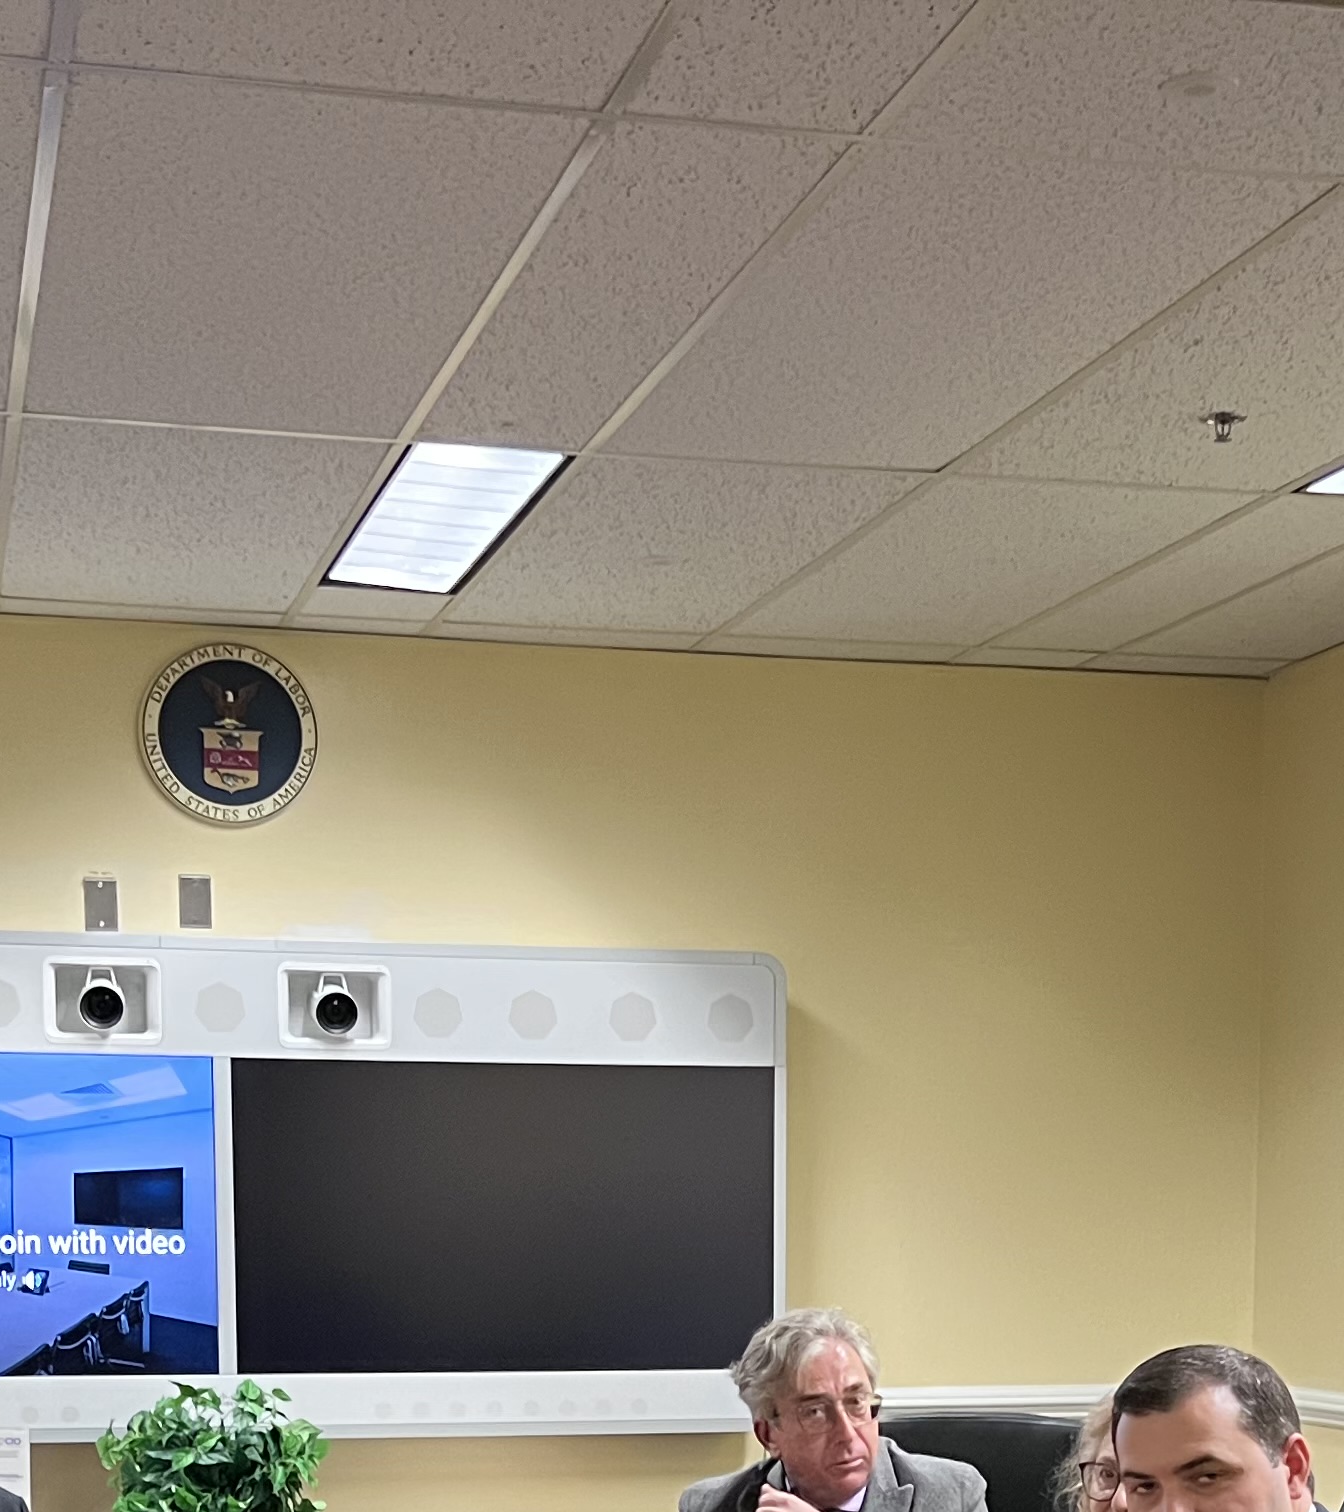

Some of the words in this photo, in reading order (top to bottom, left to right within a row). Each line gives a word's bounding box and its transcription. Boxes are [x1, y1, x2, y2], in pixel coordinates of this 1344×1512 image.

[151, 646, 245, 705] DEPARTMENT
[252, 652, 272, 669] OF
[275, 666, 311, 719] LABOR
[145, 732, 181, 795] UNITED
[185, 795, 240, 821] STATES
[248, 804, 266, 819] OF
[272, 747, 315, 810] AMERICA
[48, 1229, 106, 1255] with
[113, 1228, 186, 1255] video
